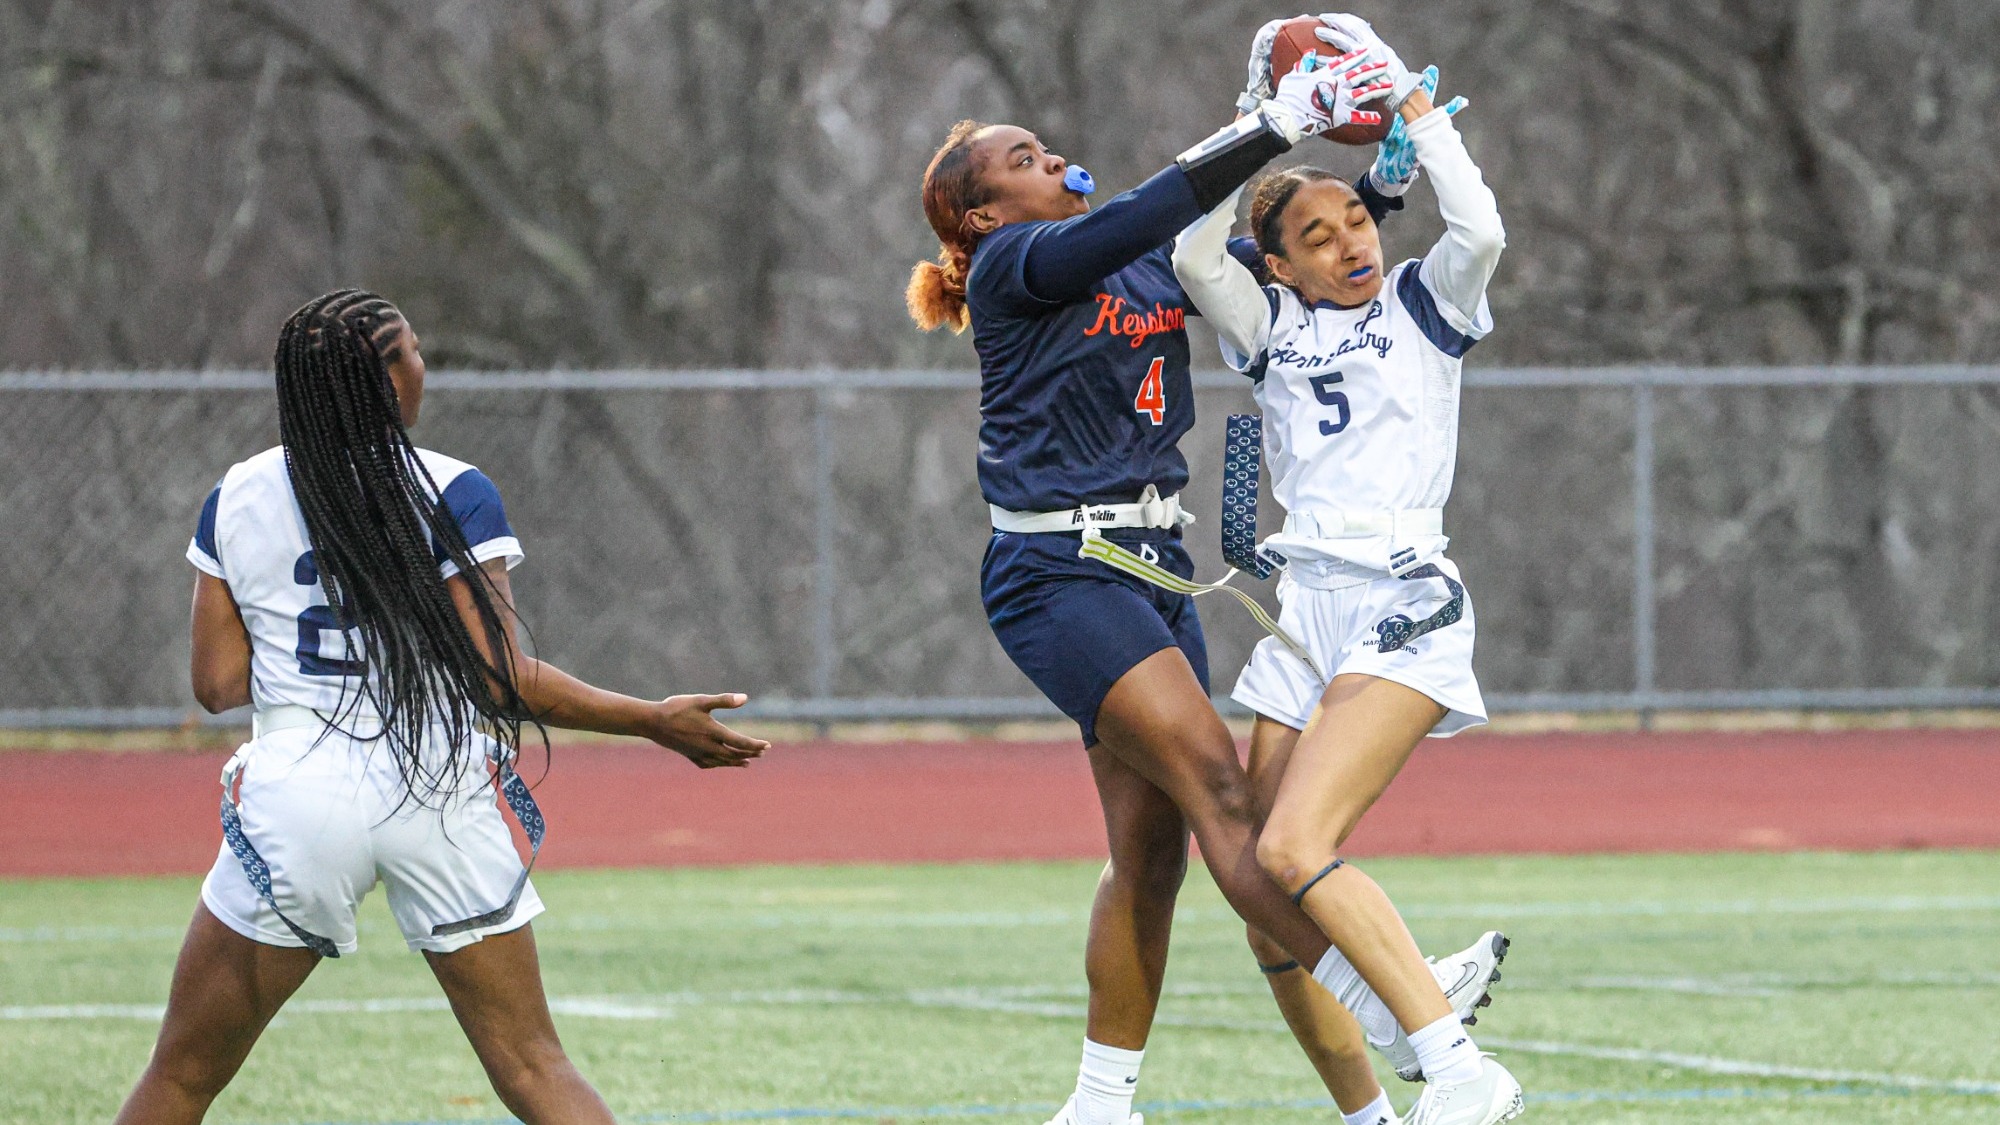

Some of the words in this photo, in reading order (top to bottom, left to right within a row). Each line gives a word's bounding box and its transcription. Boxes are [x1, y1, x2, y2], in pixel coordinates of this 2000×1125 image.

[1135, 355, 1166, 426] 4
[1308, 371, 1351, 437] 5
[1072, 509, 1116, 525] Frnklin
[294, 549, 368, 676] 2
